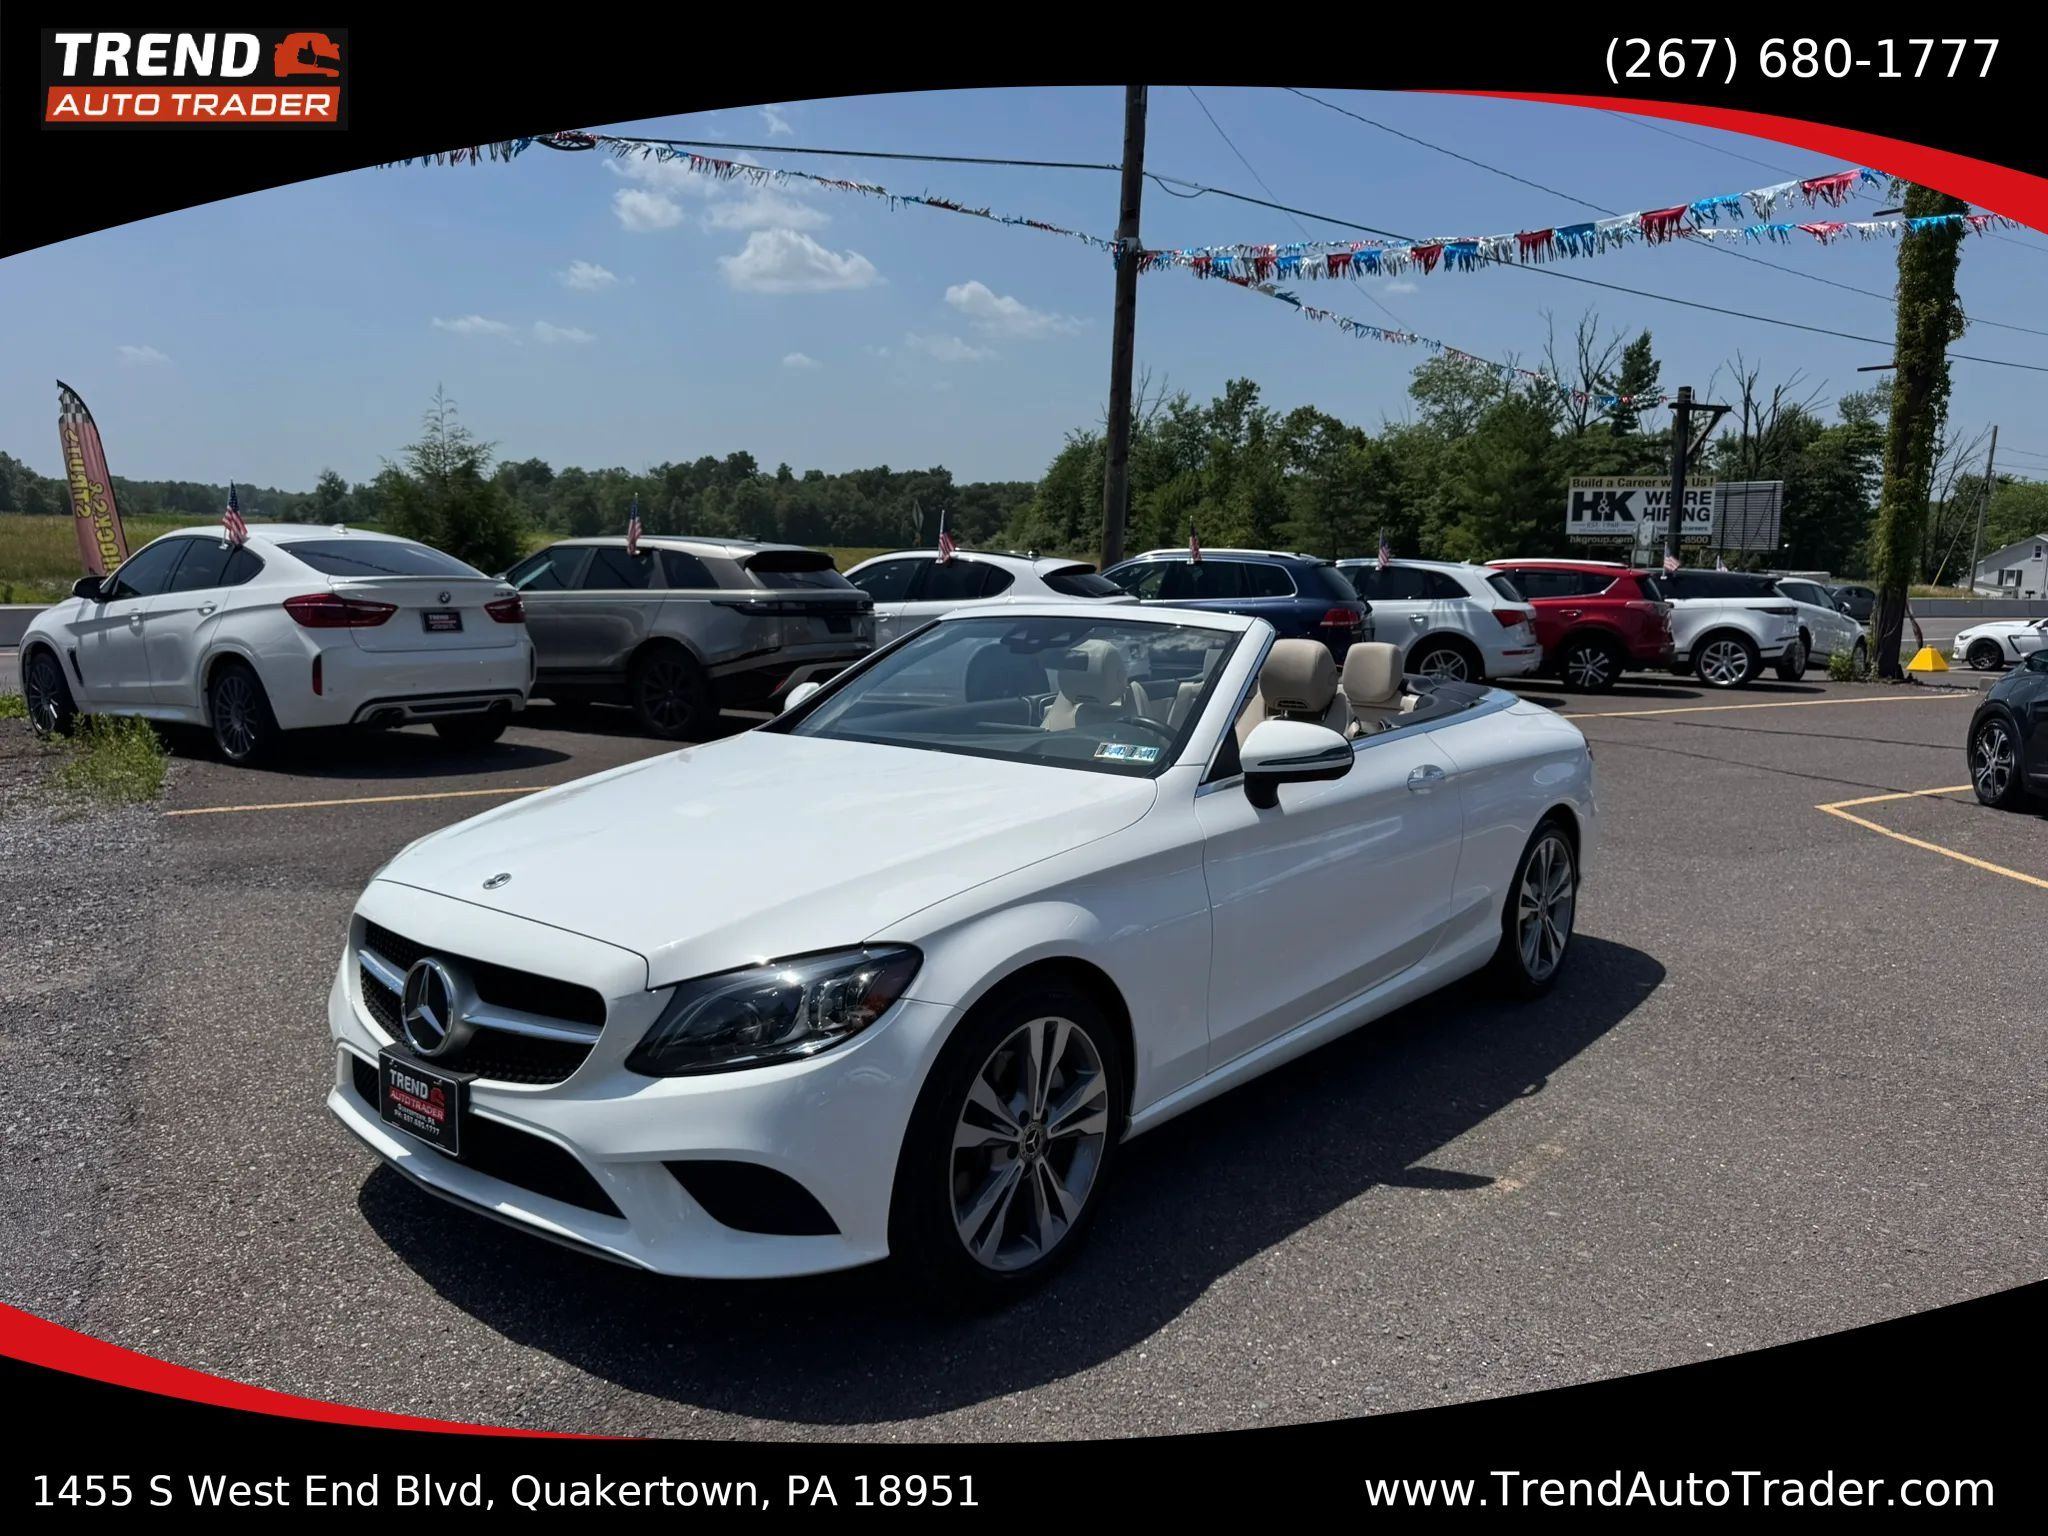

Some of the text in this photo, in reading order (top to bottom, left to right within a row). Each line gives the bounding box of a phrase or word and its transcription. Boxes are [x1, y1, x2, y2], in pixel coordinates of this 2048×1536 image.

[1572, 478, 1603, 488] Build
[1606, 480, 1614, 488] a
[1617, 478, 1657, 488] Career
[1571, 490, 1638, 522] H&K
[1645, 490, 1712, 506] WRE
[1643, 507, 1711, 522] HIRNG
[1569, 535, 1634, 545] hkgroup.com
[389, 1069, 429, 1099] TREND
[390, 1089, 411, 1105] AUTO
[411, 1097, 445, 1121] TRADER
